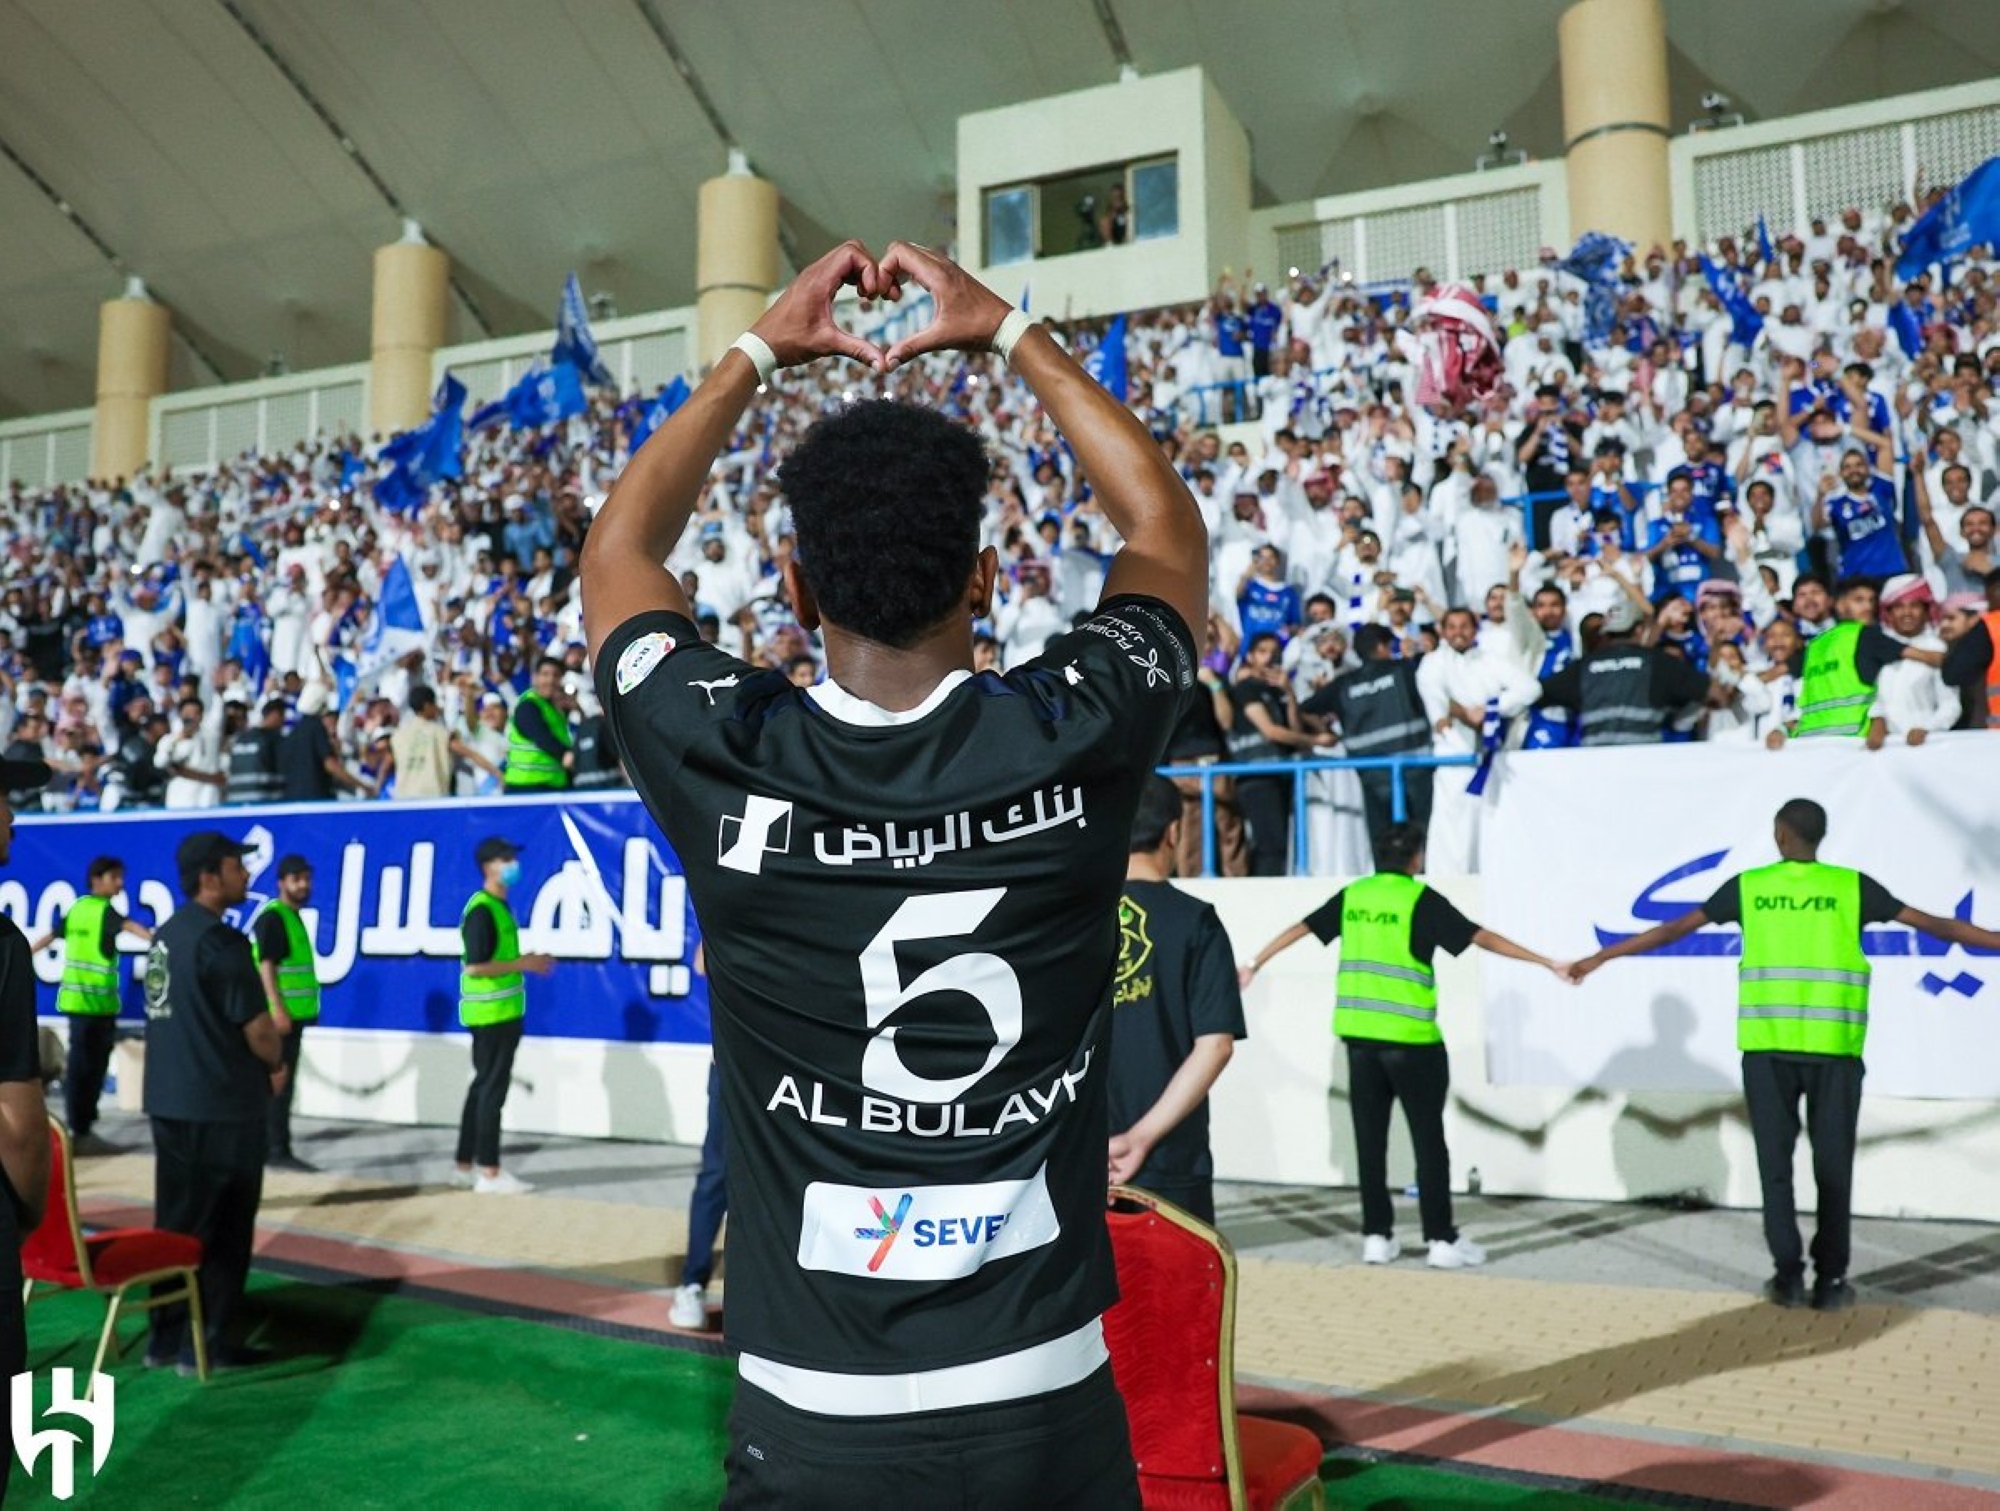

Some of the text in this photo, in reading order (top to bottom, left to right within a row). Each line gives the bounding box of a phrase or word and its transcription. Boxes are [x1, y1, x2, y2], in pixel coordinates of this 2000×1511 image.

[813, 784, 1088, 869] بنك الرياض
[858, 886, 1023, 1104] 5
[766, 1044, 1096, 1138] AL BULAYH
[913, 1212, 1013, 1248] SEVE
